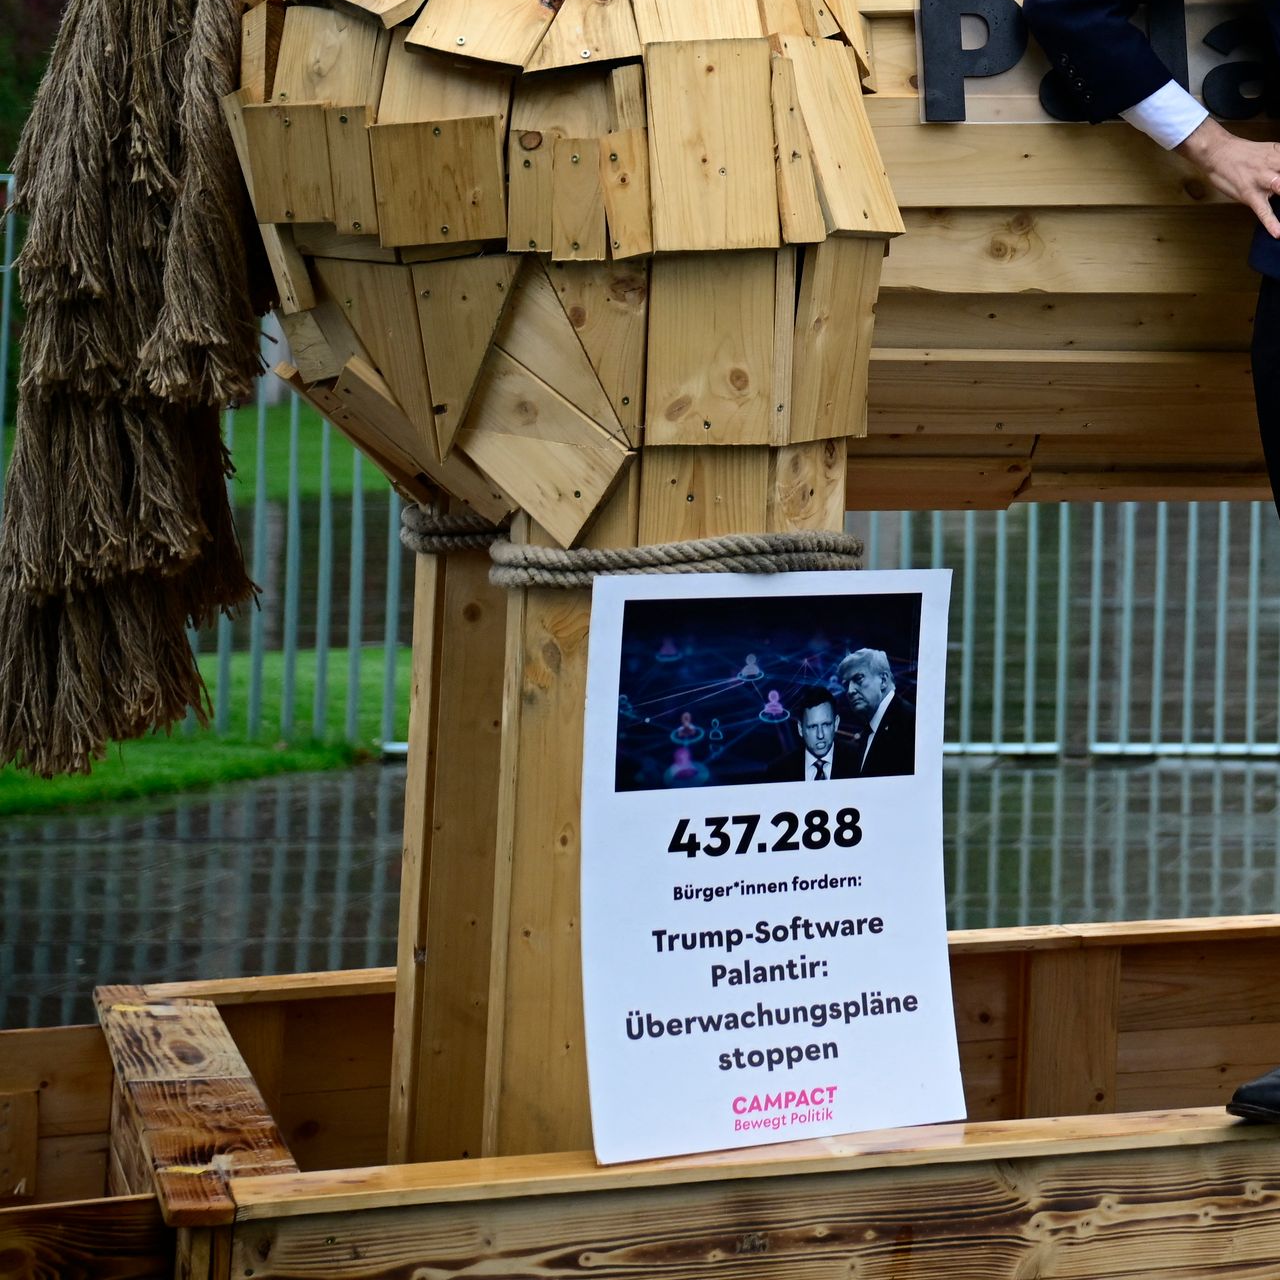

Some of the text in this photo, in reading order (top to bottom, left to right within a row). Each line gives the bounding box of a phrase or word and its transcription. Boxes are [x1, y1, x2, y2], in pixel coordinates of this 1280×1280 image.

[667, 807, 863, 858] 437.288
[791, 873, 863, 893] fordern:
[652, 914, 884, 953] Trump-Software
[710, 956, 829, 988] Palantir:
[625, 991, 919, 1041] Überwachungspläne
[718, 1040, 839, 1072] stoppen
[732, 1086, 838, 1115] CAMPACT
[733, 1108, 833, 1132] Bewegt Politik
